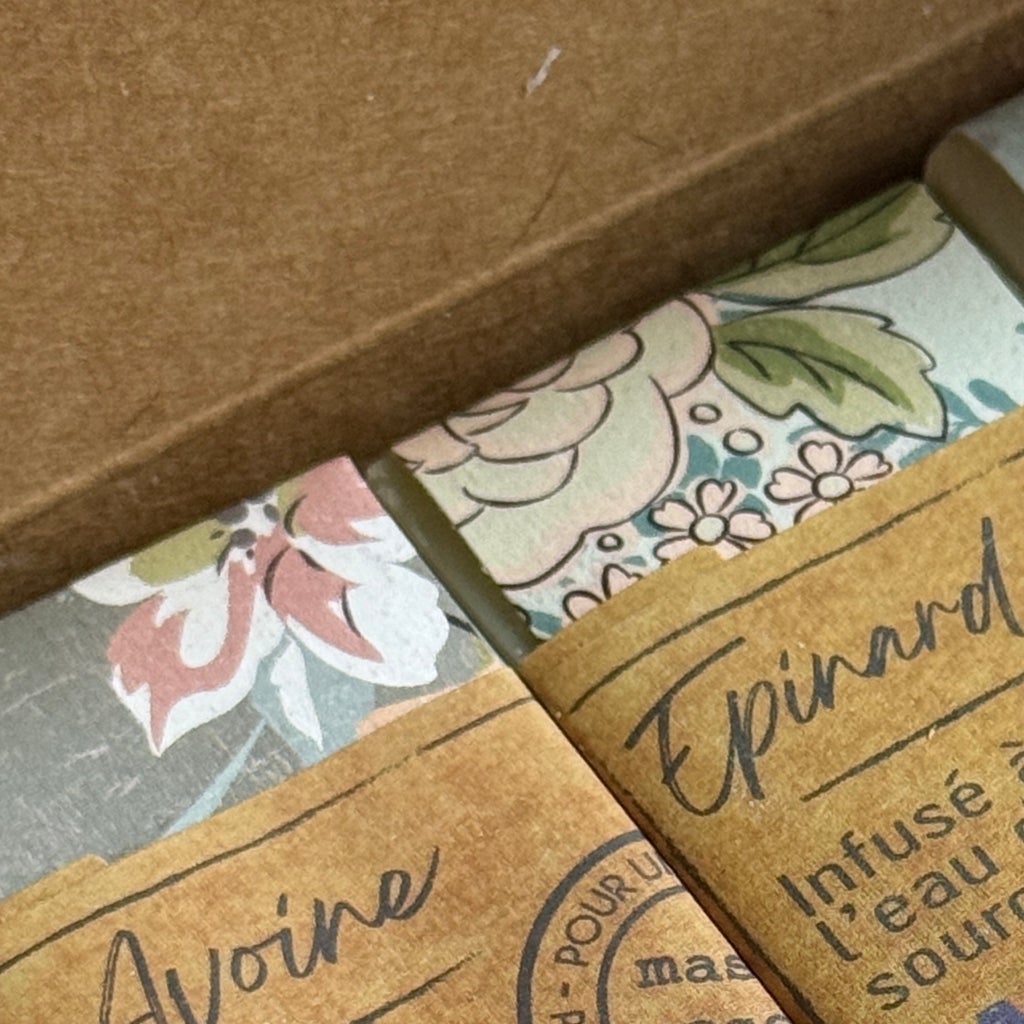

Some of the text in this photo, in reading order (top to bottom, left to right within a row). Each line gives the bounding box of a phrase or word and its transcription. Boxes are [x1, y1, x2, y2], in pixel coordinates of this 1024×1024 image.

[777, 768, 994, 918] Infusé
[554, 873, 637, 967] POUR
[634, 953, 755, 989] mas
